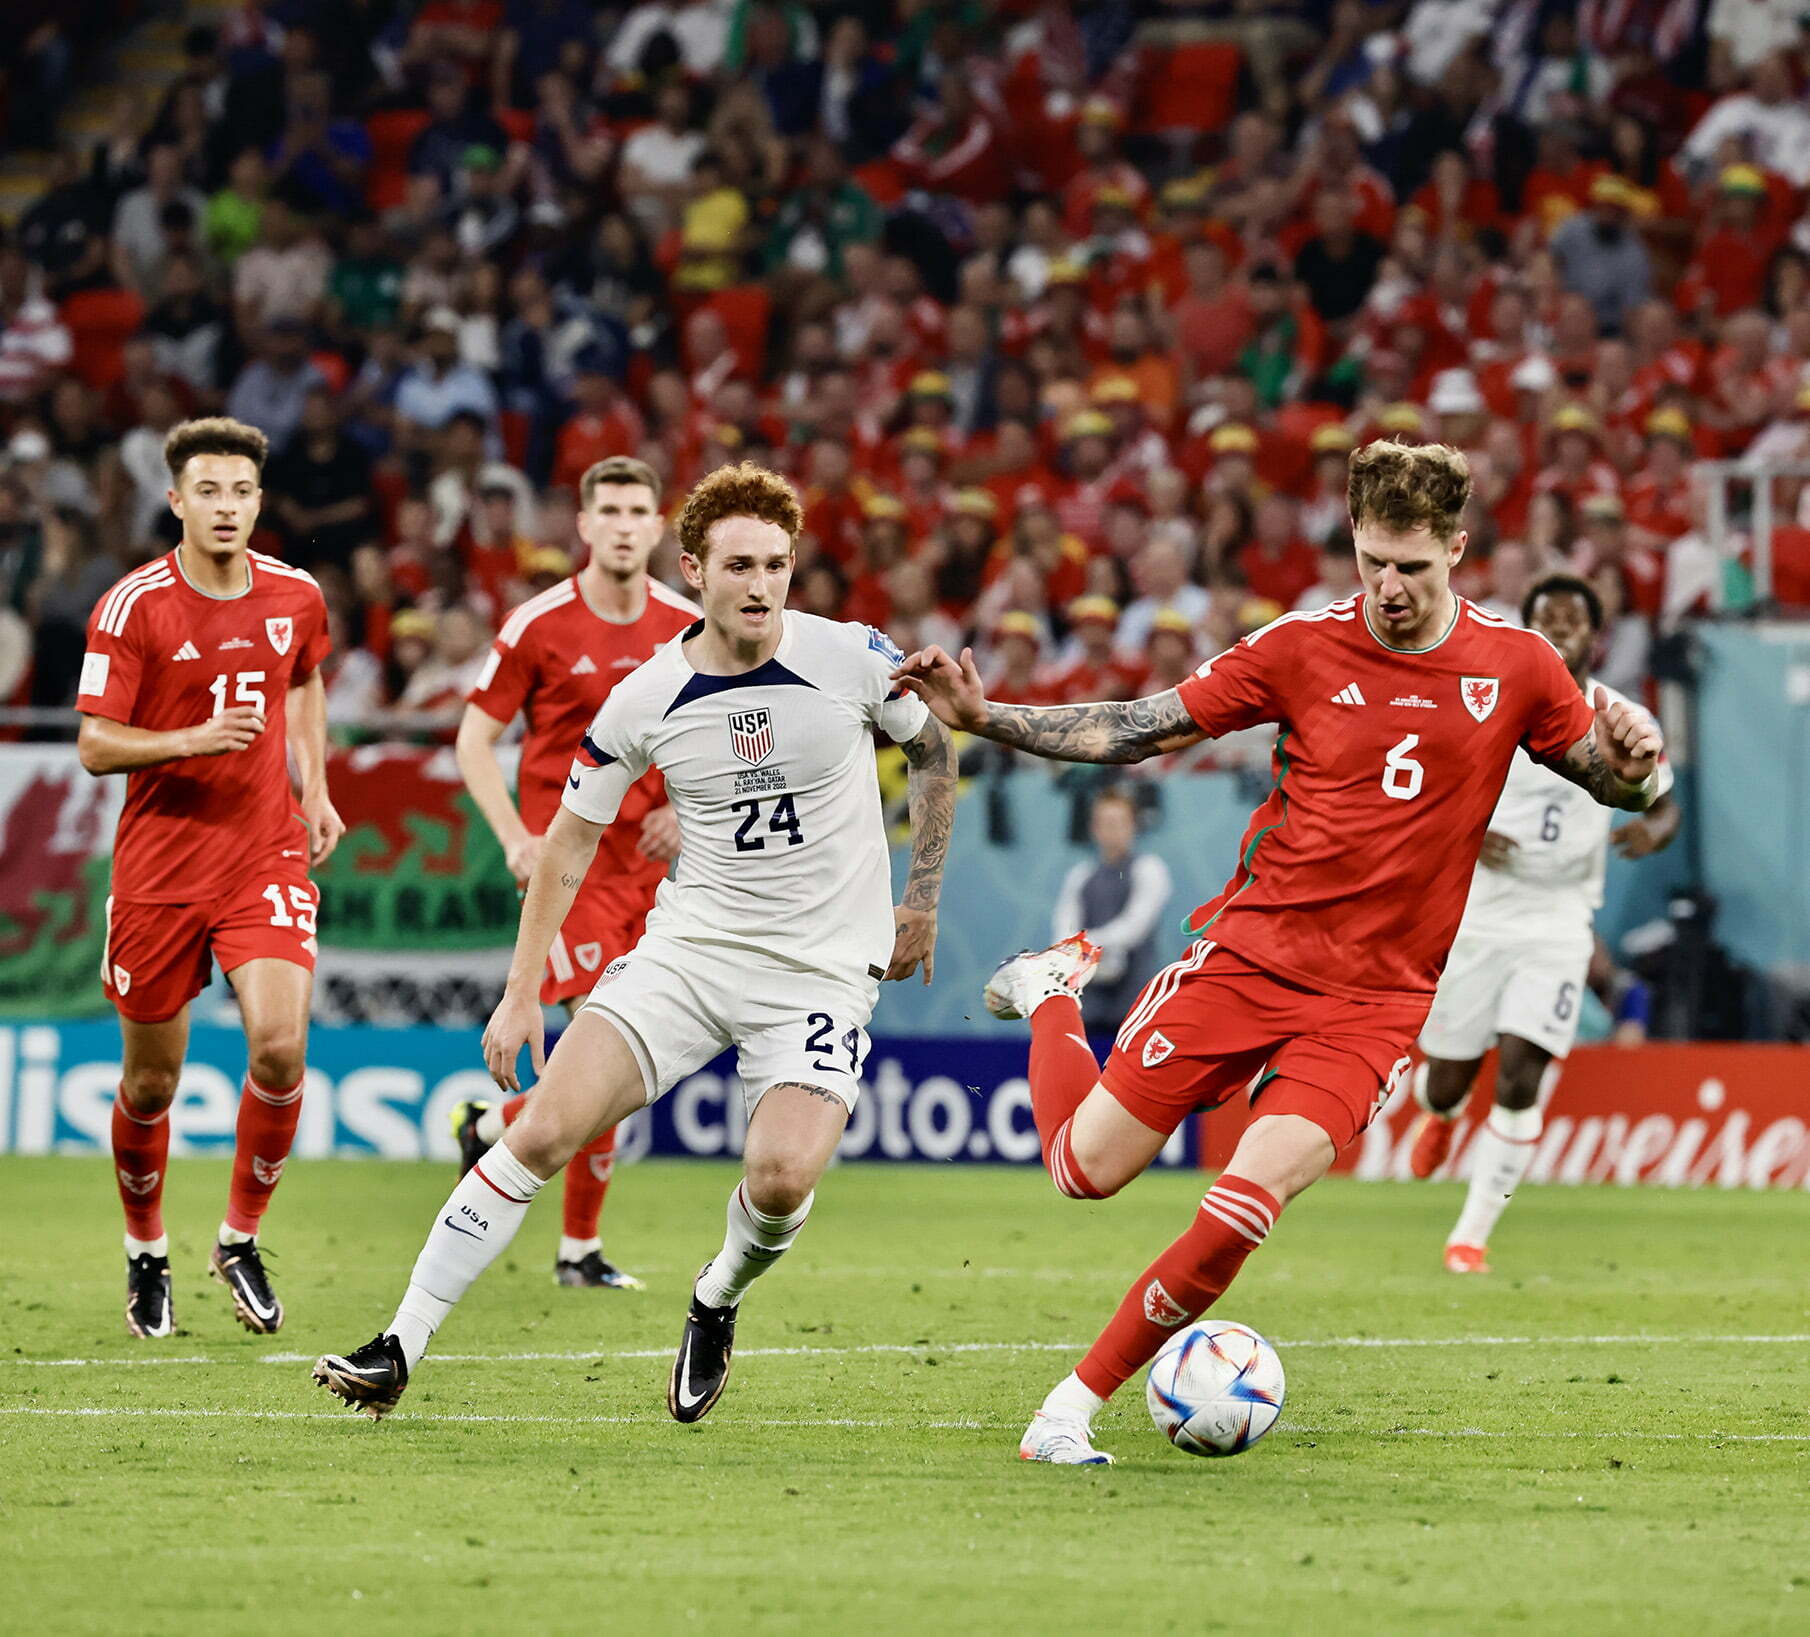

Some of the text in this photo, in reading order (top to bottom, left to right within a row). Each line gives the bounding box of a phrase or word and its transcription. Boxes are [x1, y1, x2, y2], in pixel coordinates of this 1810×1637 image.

[208, 671, 265, 717] 15
[732, 711, 768, 734] USA
[760, 769, 781, 777] WALES
[768, 775, 786, 783] QATAR
[1381, 733, 1425, 800] 6
[734, 782, 787, 795] 21 NOVEMBER 2022
[731, 793, 804, 852] 24
[1541, 804, 1563, 842] 6
[262, 884, 319, 935] 15
[606, 963, 627, 975] USA
[1554, 981, 1577, 1021] 6
[805, 1012, 859, 1074] 24
[0, 1026, 514, 1160] isese
[460, 1205, 489, 1231] USA
